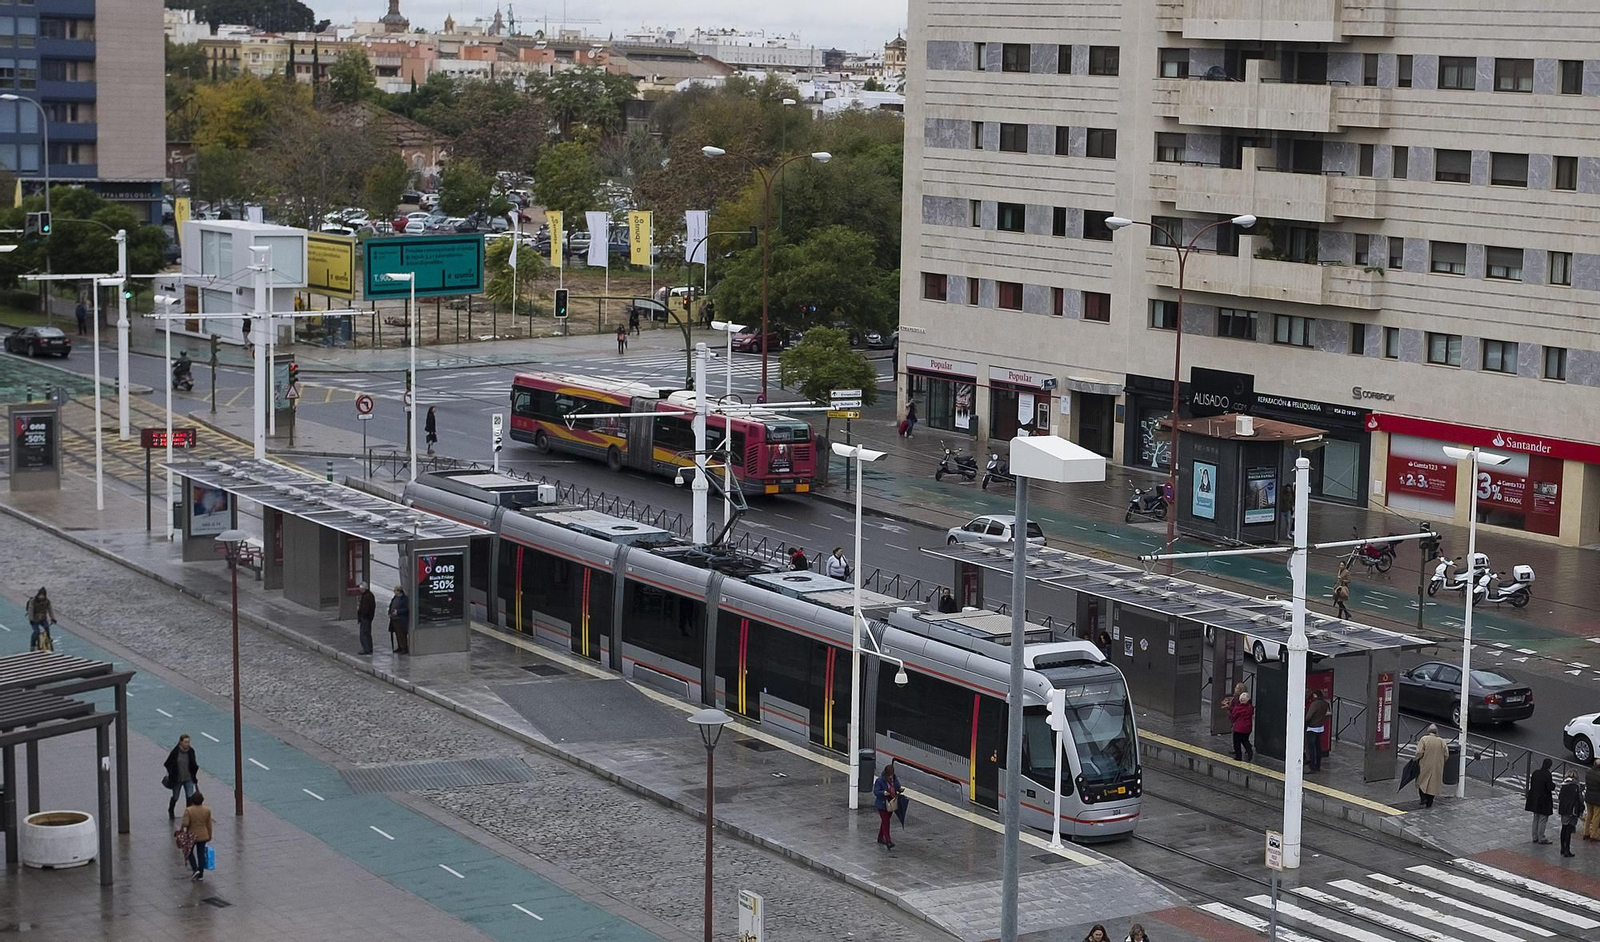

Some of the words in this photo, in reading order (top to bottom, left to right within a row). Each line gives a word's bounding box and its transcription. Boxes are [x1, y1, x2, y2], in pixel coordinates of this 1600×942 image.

[930, 360, 953, 370] Popular
[1008, 371, 1032, 382] Popular
[1193, 392, 1229, 408] ALISADO
[1506, 437, 1551, 454] Santander
[1477, 472, 1502, 500] 3%
[435, 564, 455, 573] one
[429, 580, 455, 590] -50%
